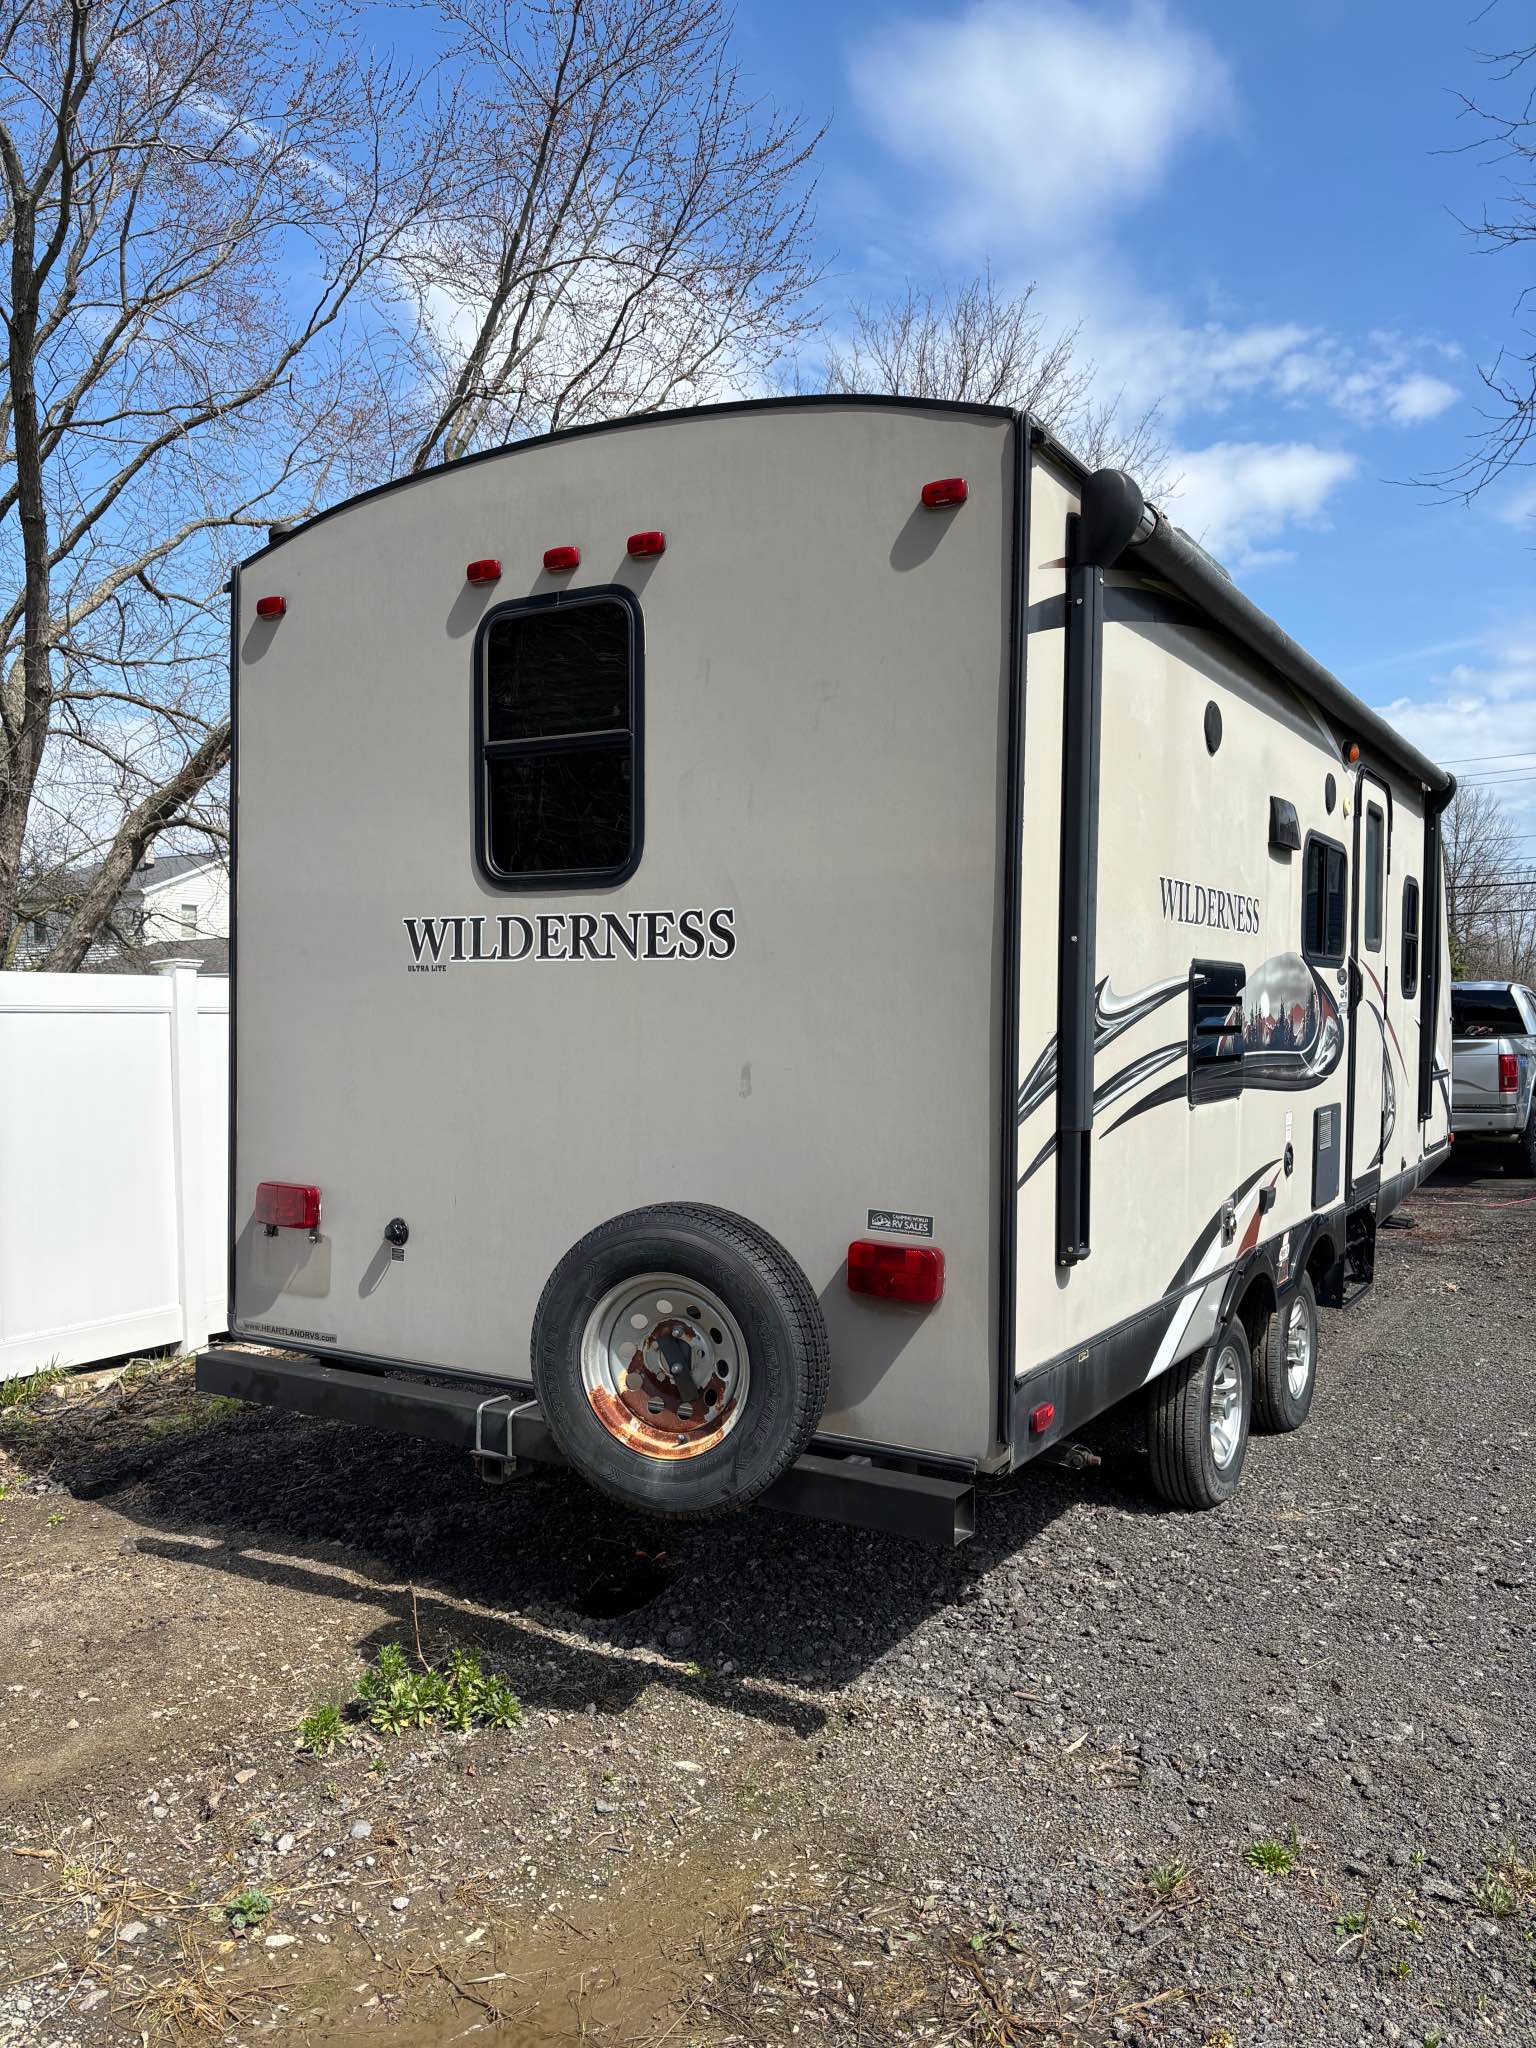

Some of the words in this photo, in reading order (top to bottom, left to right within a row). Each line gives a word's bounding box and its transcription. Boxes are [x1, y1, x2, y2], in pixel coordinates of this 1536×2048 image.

[1159, 876, 1260, 935] WILDERNESS
[403, 907, 737, 963] WILDERNESS
[407, 965, 430, 973] ULTRA
[892, 1219, 904, 1228] RV
[904, 1221, 929, 1232] SALES
[244, 1323, 337, 1343] www.HEARTLANDRVS.com
